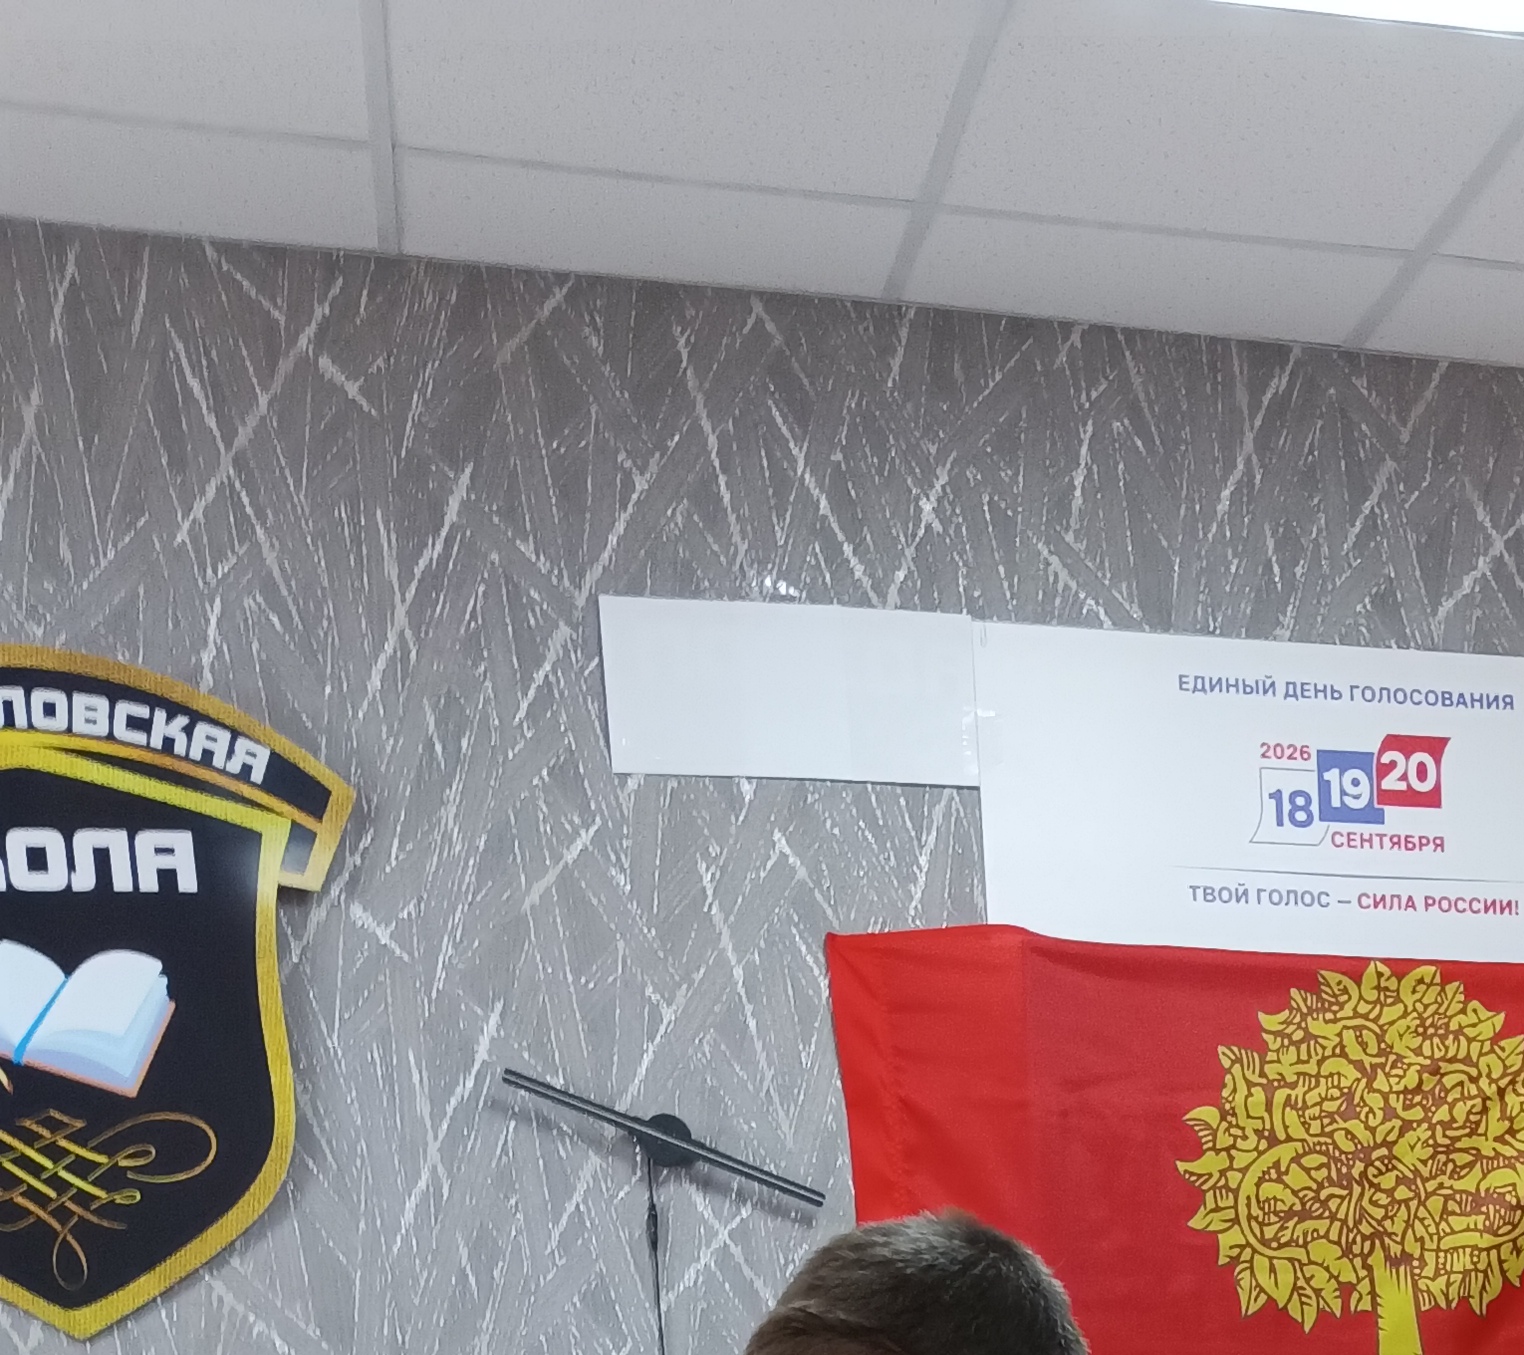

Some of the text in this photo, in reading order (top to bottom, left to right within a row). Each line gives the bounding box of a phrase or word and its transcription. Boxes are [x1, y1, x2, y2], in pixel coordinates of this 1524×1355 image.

[1178, 673, 1515, 711] ЕДИНЫЙ ДЕНЬ ГОЛОСОВАНИЯ
[1259, 742, 1312, 761] 2026
[1268, 751, 1437, 828] 18 19 20
[0, 826, 198, 893] ОЛА
[1331, 831, 1445, 853] СЕНТЯБРЯ
[1189, 883, 1249, 904] ТВОЙ
[1256, 888, 1331, 908] ГОЛОС
[1357, 892, 1417, 912] СИЛА
[1424, 895, 1519, 916] РОССИИ!
